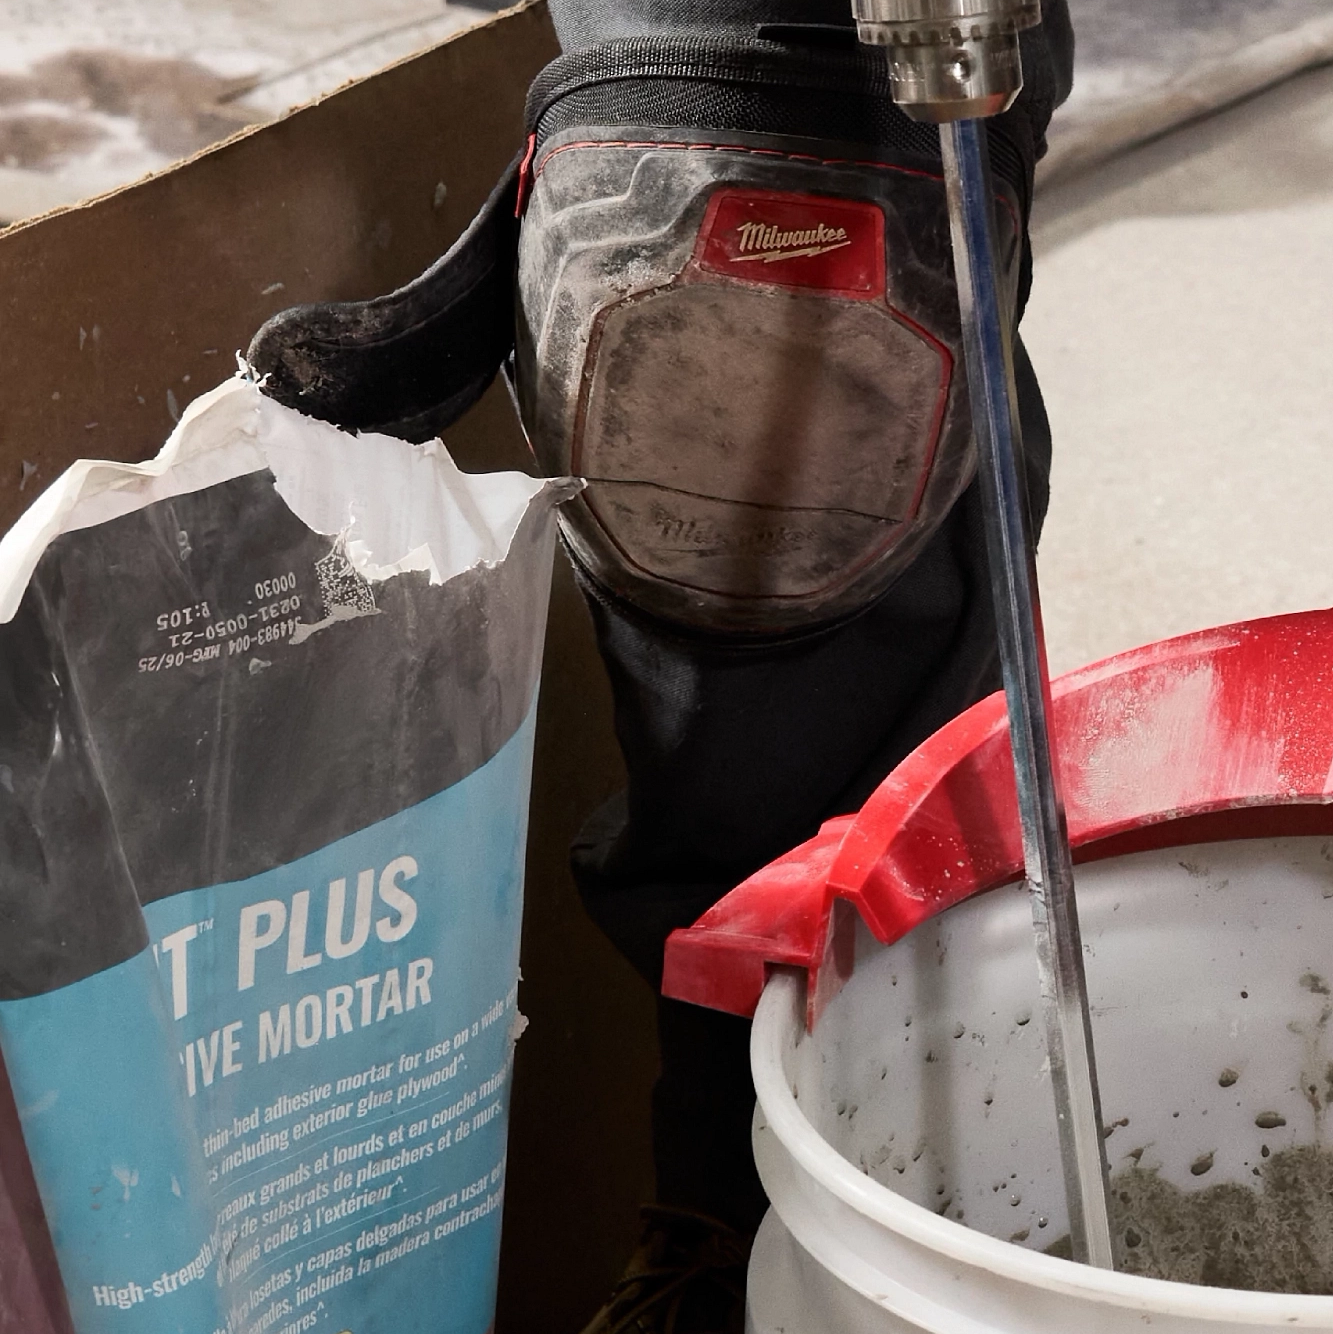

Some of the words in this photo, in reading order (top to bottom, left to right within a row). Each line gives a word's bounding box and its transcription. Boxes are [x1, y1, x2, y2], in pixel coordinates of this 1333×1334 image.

[737, 222, 848, 252] Milwaukee
[254, 571, 296, 601] 00030
[238, 855, 419, 992] PLUS
[179, 1020, 243, 1097] IVE
[257, 957, 434, 1064] MORTAR
[203, 1107, 260, 1158] thin-bed
[264, 1084, 332, 1124] adhesive
[336, 1062, 394, 1095] mortar
[398, 1052, 422, 1075] for
[425, 1040, 451, 1064] use
[454, 1028, 469, 1050] on
[471, 1022, 479, 1037] a
[481, 1000, 504, 1030] wide
[221, 1128, 290, 1175] including
[293, 1101, 354, 1141] exterior
[356, 1089, 393, 1117] glue
[240, 1216, 258, 1238] de
[261, 1182, 329, 1227] substrats
[333, 1170, 352, 1193] de
[356, 1141, 434, 1188] planchers
[437, 1129, 451, 1152] et
[455, 1121, 470, 1143] de
[473, 1099, 503, 1132] murs
[260, 1164, 311, 1206] grands
[314, 1152, 329, 1174] et
[333, 1133, 384, 1166] lourds
[388, 1125, 404, 1147] et
[408, 1118, 428, 1139] en
[431, 1091, 478, 1129] couche
[93, 1243, 213, 1310] High-strength
[249, 1268, 292, 1310] losetas
[294, 1262, 303, 1281] y
[307, 1240, 353, 1272] capas
[356, 1210, 423, 1251] delgadas
[425, 1193, 458, 1224] para
[461, 1173, 489, 1203] usar
[264, 1220, 299, 1253] collé
[302, 1213, 312, 1235] à
[296, 1266, 354, 1306] incluida
[357, 1256, 372, 1276] la
[375, 1231, 431, 1268] madera
